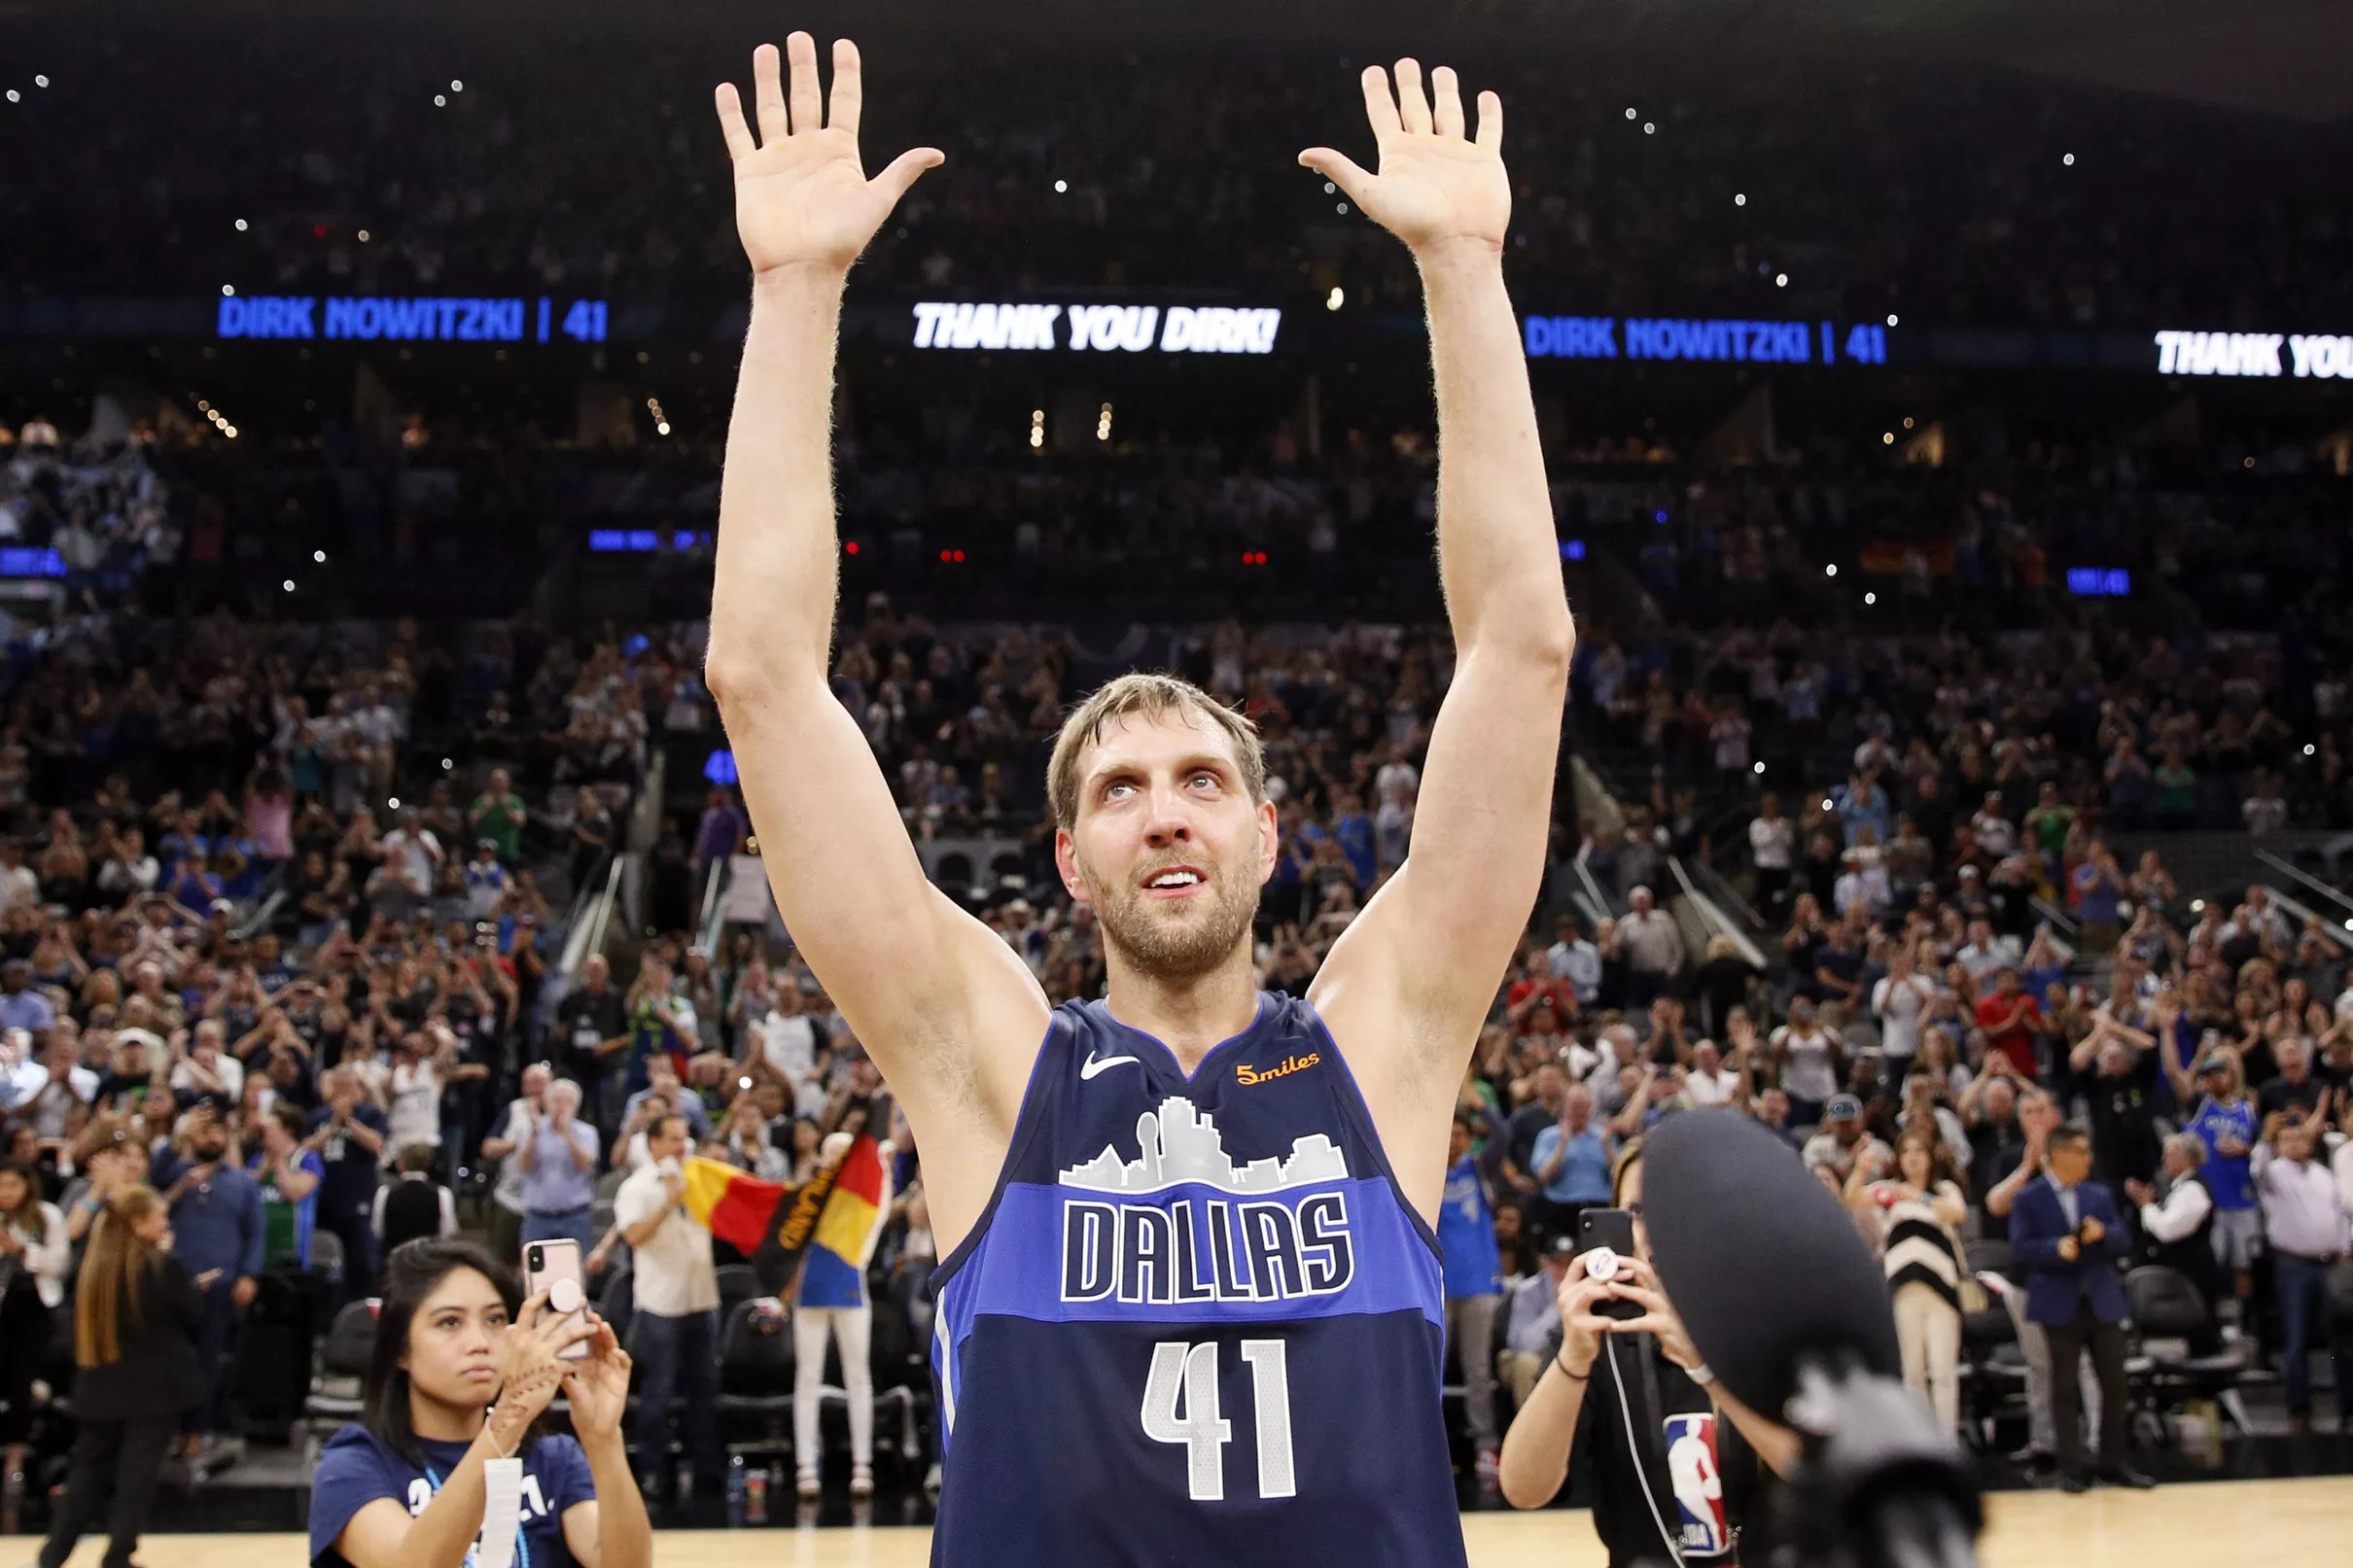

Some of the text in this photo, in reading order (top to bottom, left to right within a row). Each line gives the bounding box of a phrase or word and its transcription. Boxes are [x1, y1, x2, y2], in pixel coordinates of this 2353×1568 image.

[218, 296, 315, 339] DIRK
[325, 296, 525, 340] NOWITZKI
[562, 298, 608, 342] 41
[912, 302, 1282, 354] THANK YOU DIRK!
[1524, 315, 1617, 358] DIRK
[1625, 317, 1810, 364] NOWITZKI
[1845, 324, 1887, 365] 41
[2154, 330, 2285, 377] THANK
[1236, 1052, 1320, 1086] 5miles
[1060, 1191, 1355, 1305] DALLAS
[1140, 1339, 1297, 1501] 41
